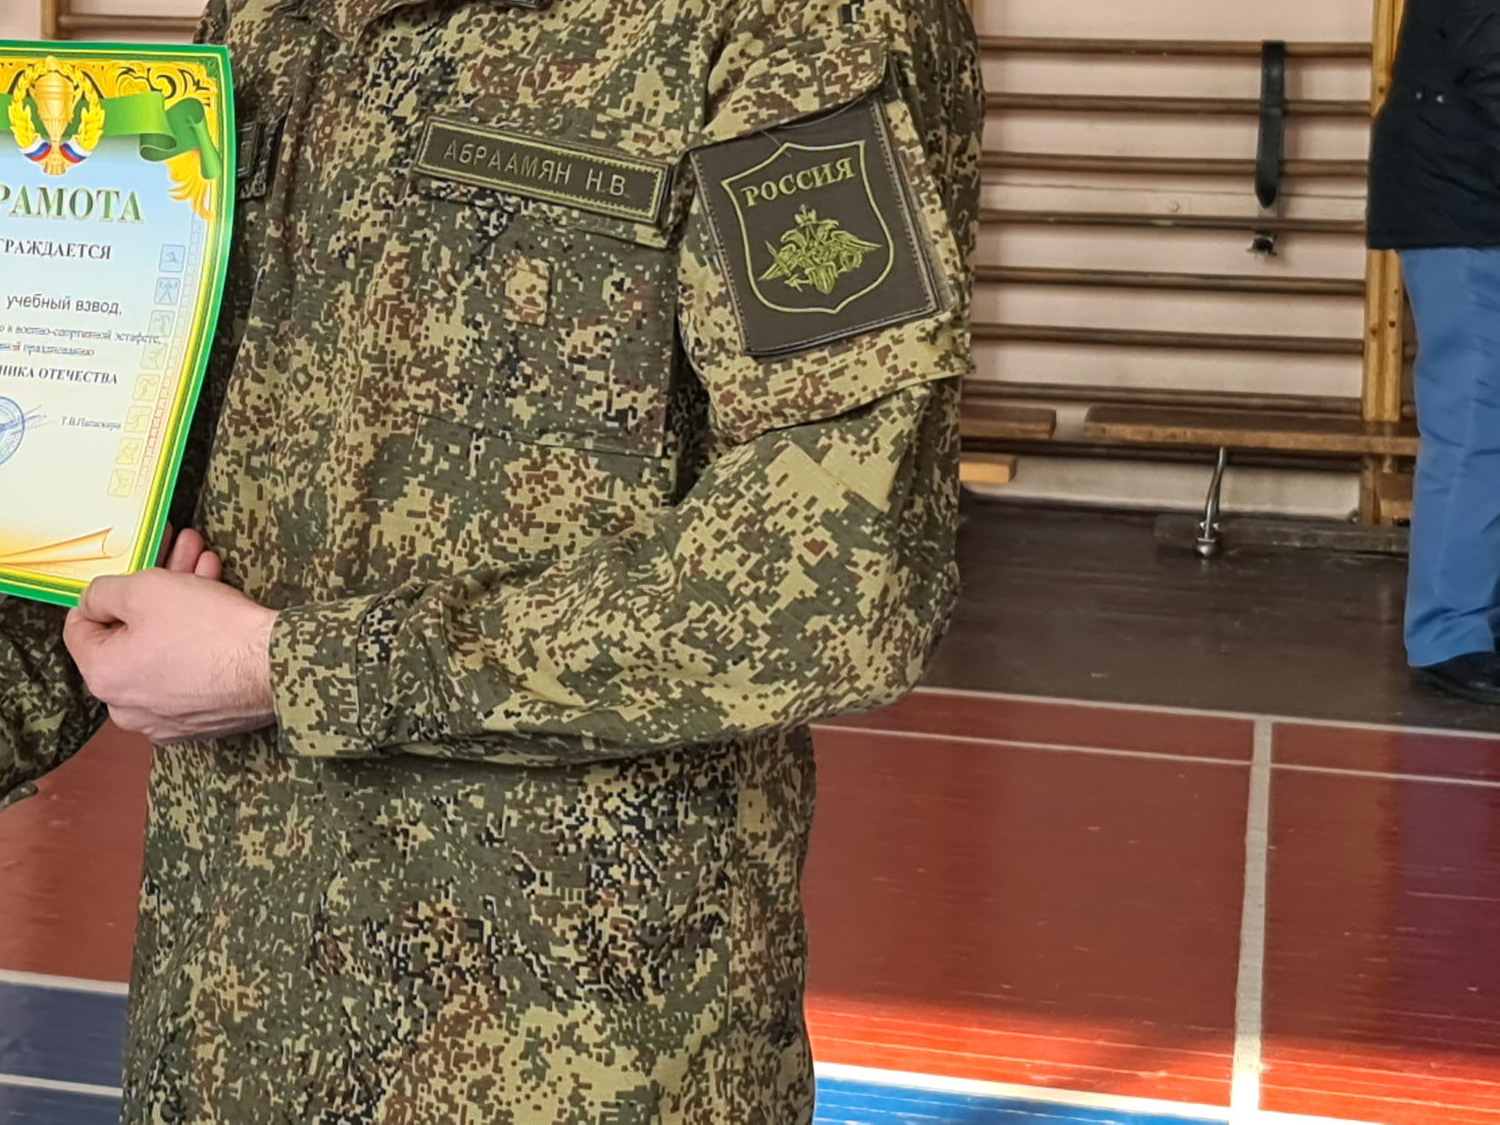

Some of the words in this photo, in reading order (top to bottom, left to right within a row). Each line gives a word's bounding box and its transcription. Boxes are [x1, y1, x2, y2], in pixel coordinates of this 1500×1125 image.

[443, 139, 572, 185] АБРААМЯН
[740, 157, 855, 207] РОССИЯ
[6, 294, 71, 311] учебный
[38, 367, 118, 385] ОТЕЧЕСТВА
